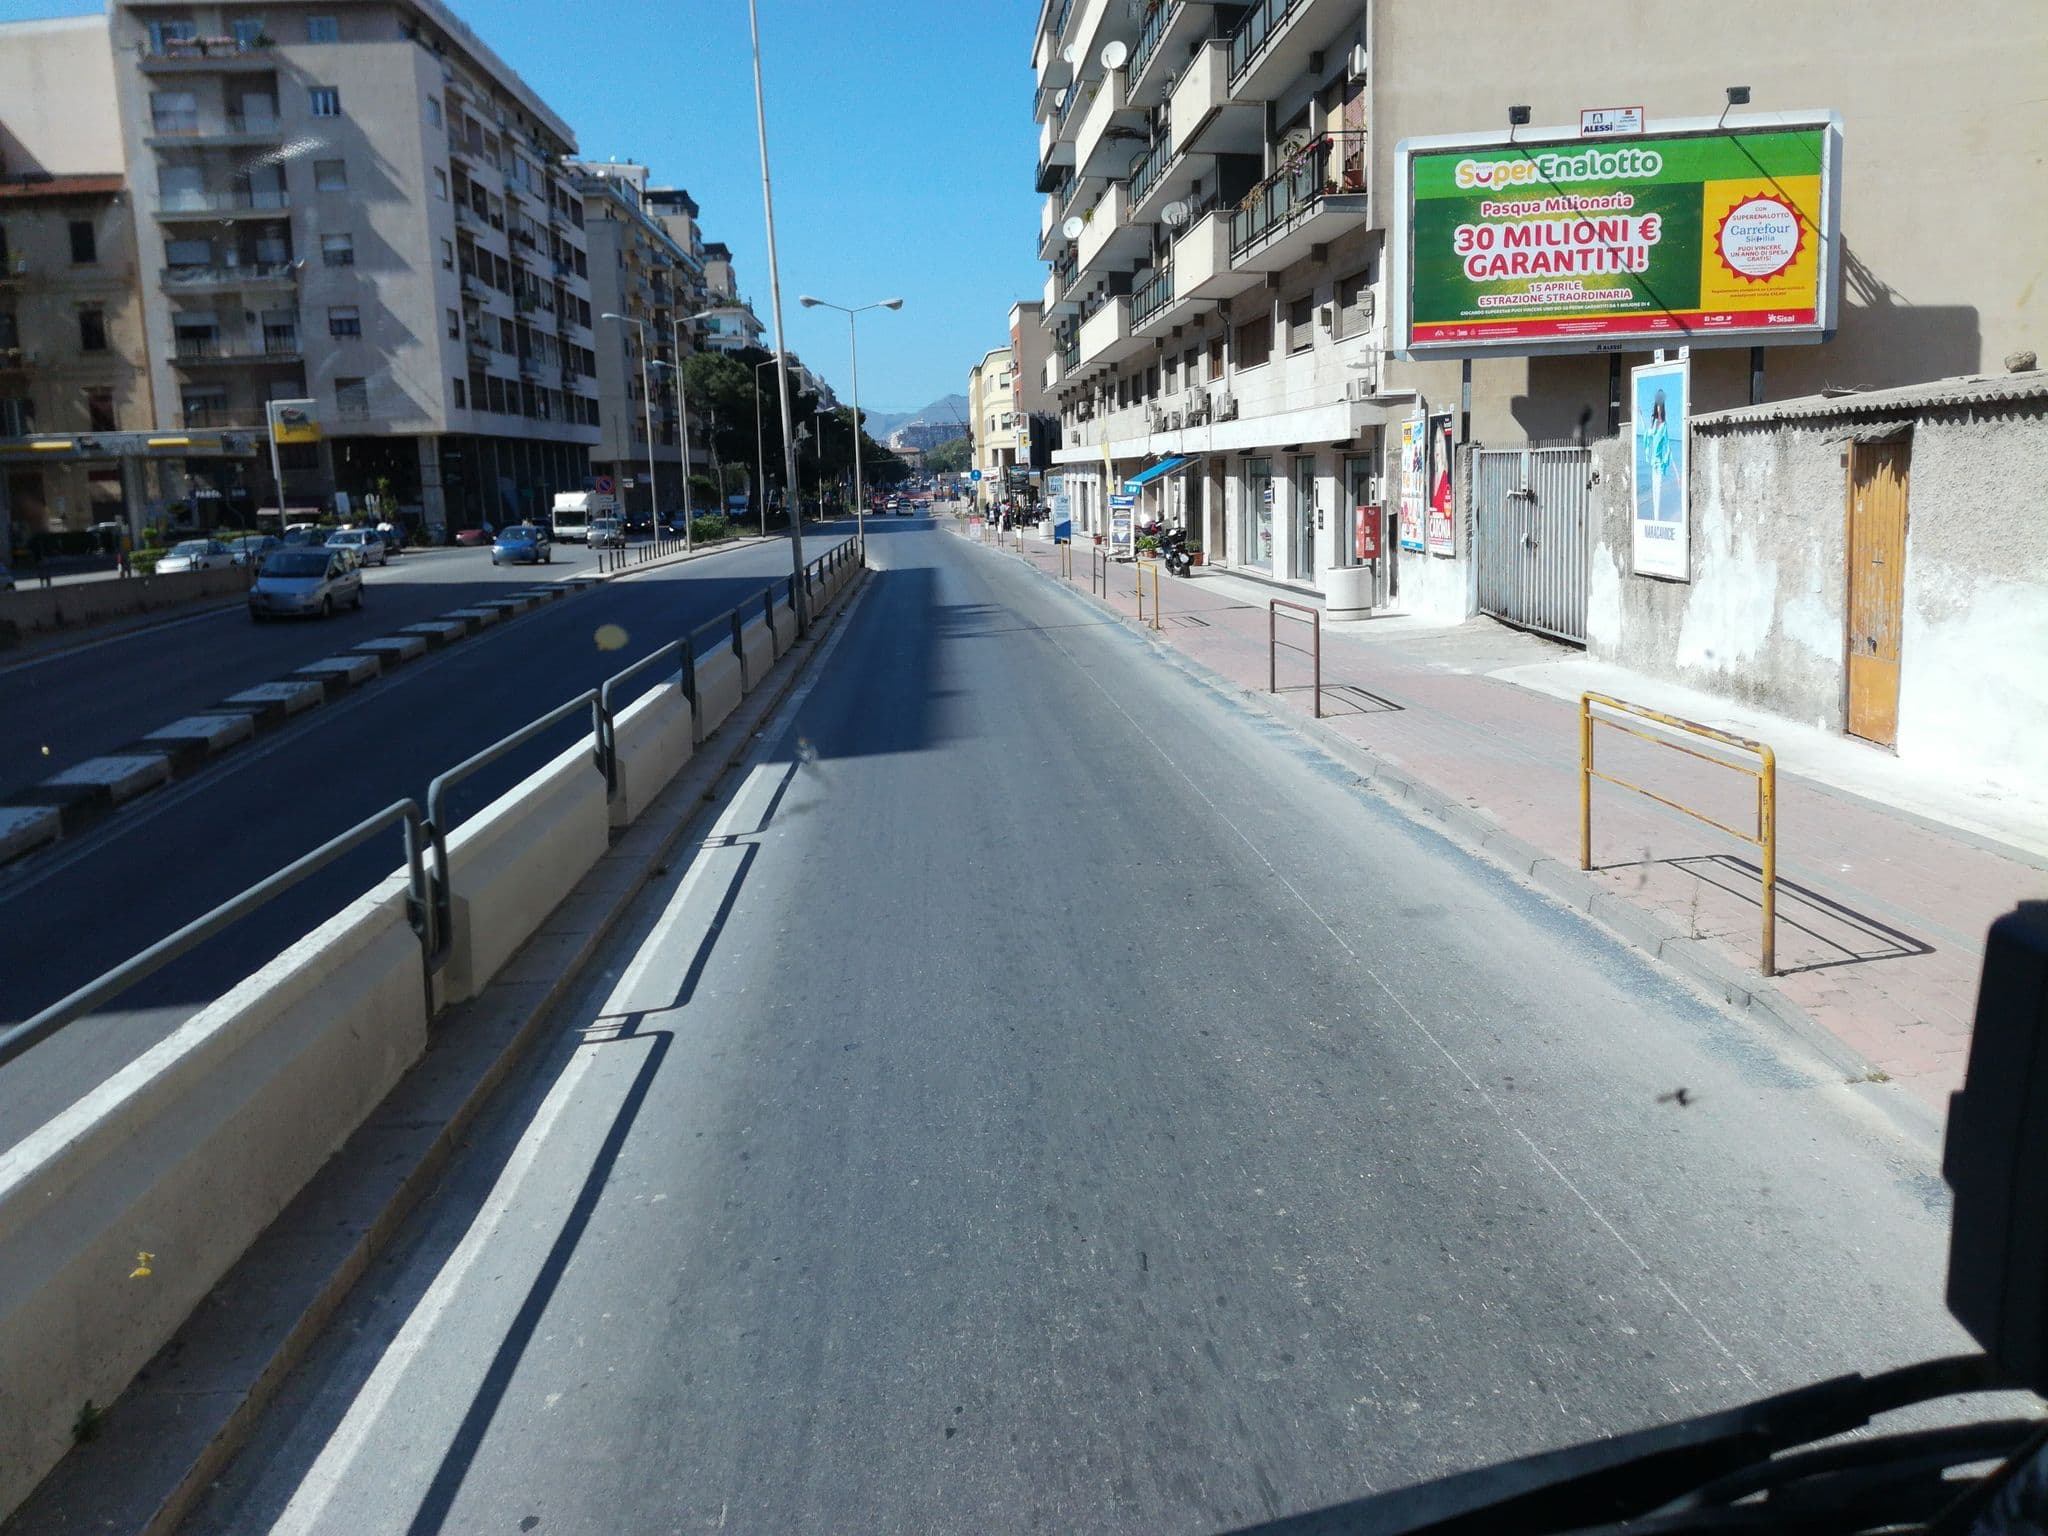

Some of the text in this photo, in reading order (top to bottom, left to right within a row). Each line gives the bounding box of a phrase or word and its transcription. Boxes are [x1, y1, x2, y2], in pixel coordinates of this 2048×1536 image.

[1458, 152, 1659, 186] SuperEnalotto
[1483, 193, 1633, 216] Pasqua Milionaria
[1457, 217, 1658, 251] 30 MILIONI €
[1730, 223, 1791, 236] Carrefour
[1467, 246, 1645, 277] GARANTITI!
[1530, 281, 1581, 292] 15 APRILE
[1480, 290, 1631, 306] ESTRAZIONE STRAORDINARIA
[1776, 315, 1795, 323] Sisal
